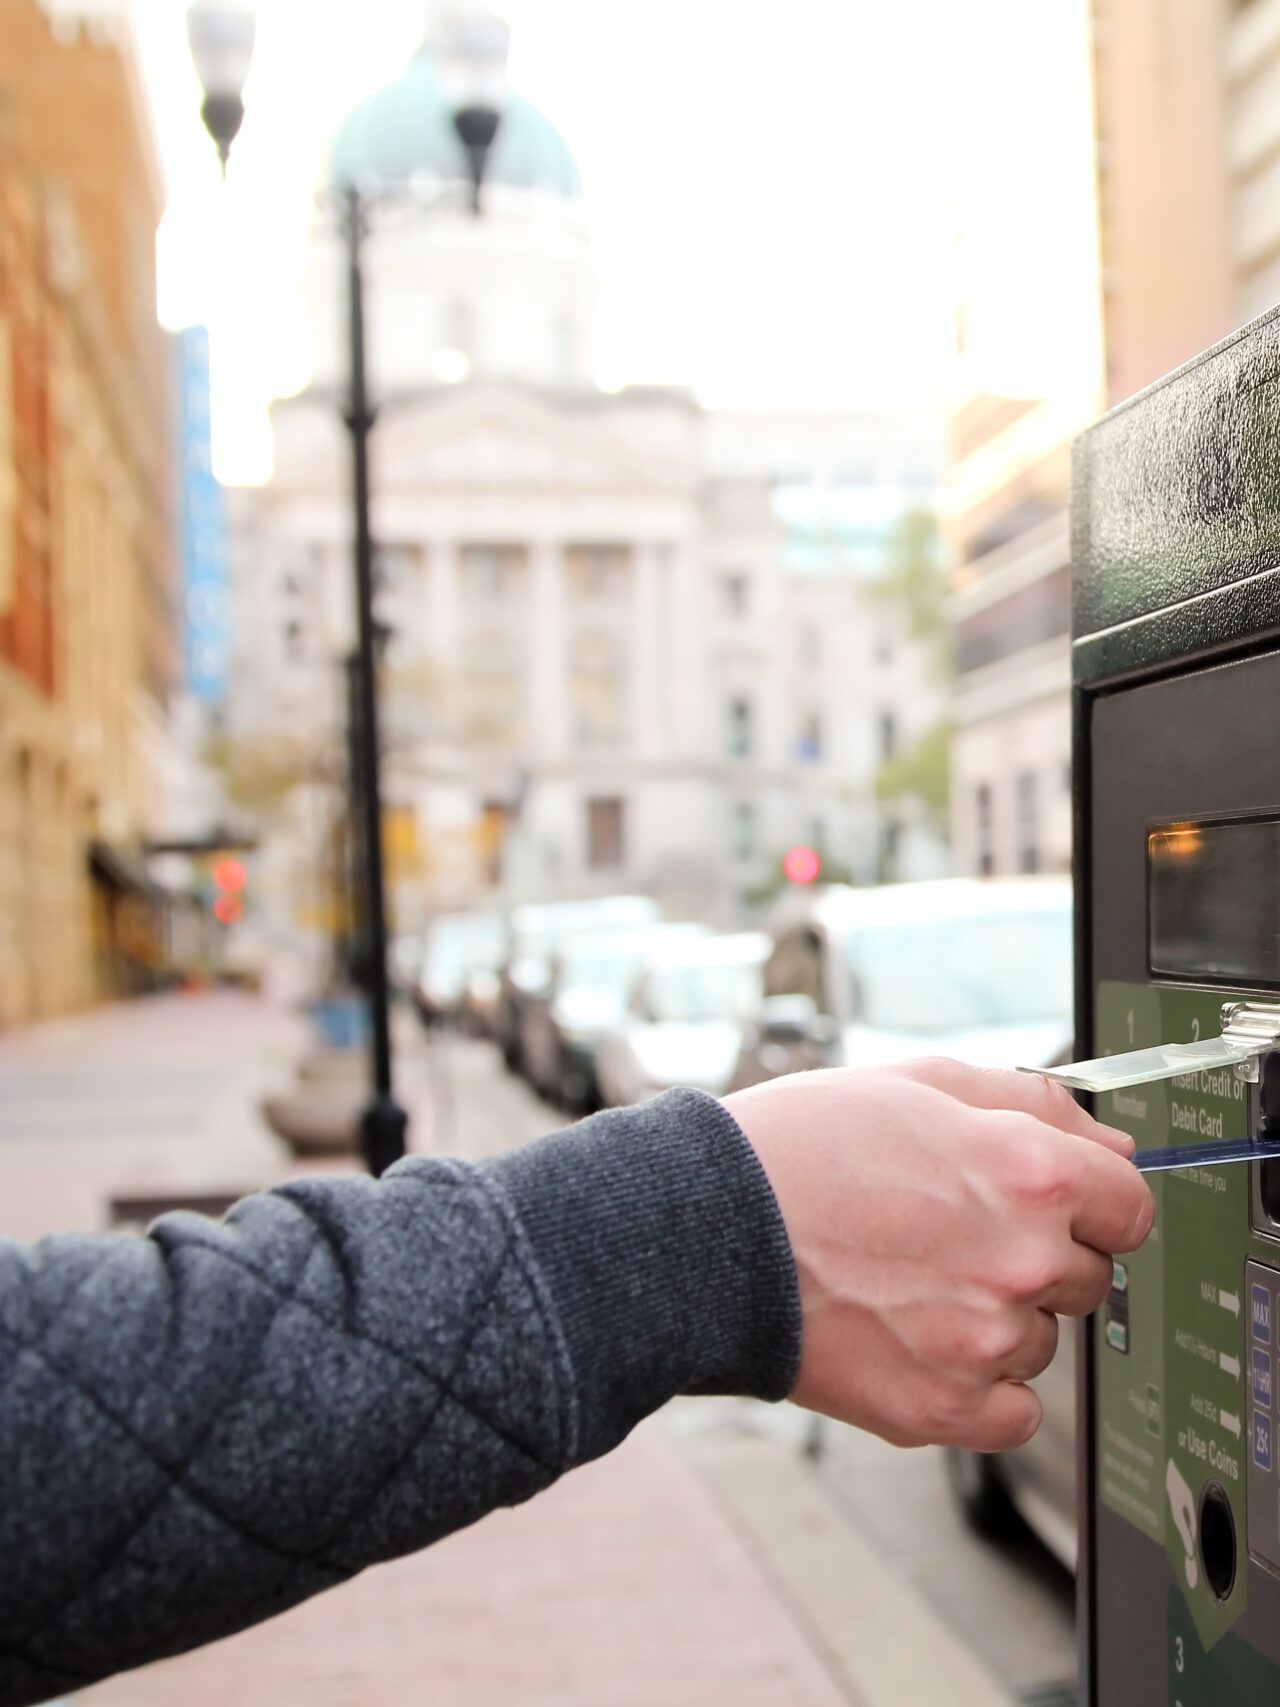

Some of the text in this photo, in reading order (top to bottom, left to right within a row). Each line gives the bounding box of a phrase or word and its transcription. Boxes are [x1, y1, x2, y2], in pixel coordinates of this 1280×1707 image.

[1200, 1069, 1231, 1098] Credit
[1233, 1080, 1245, 1101] or
[1172, 1102, 1223, 1138] Debit Card
[1253, 1300, 1270, 1329] MAX
[1188, 1426, 1207, 1460] Use
[1209, 1439, 1239, 1480] Coins
[1256, 1426, 1268, 1455] 25¢
[1175, 1636, 1184, 1672] 3
